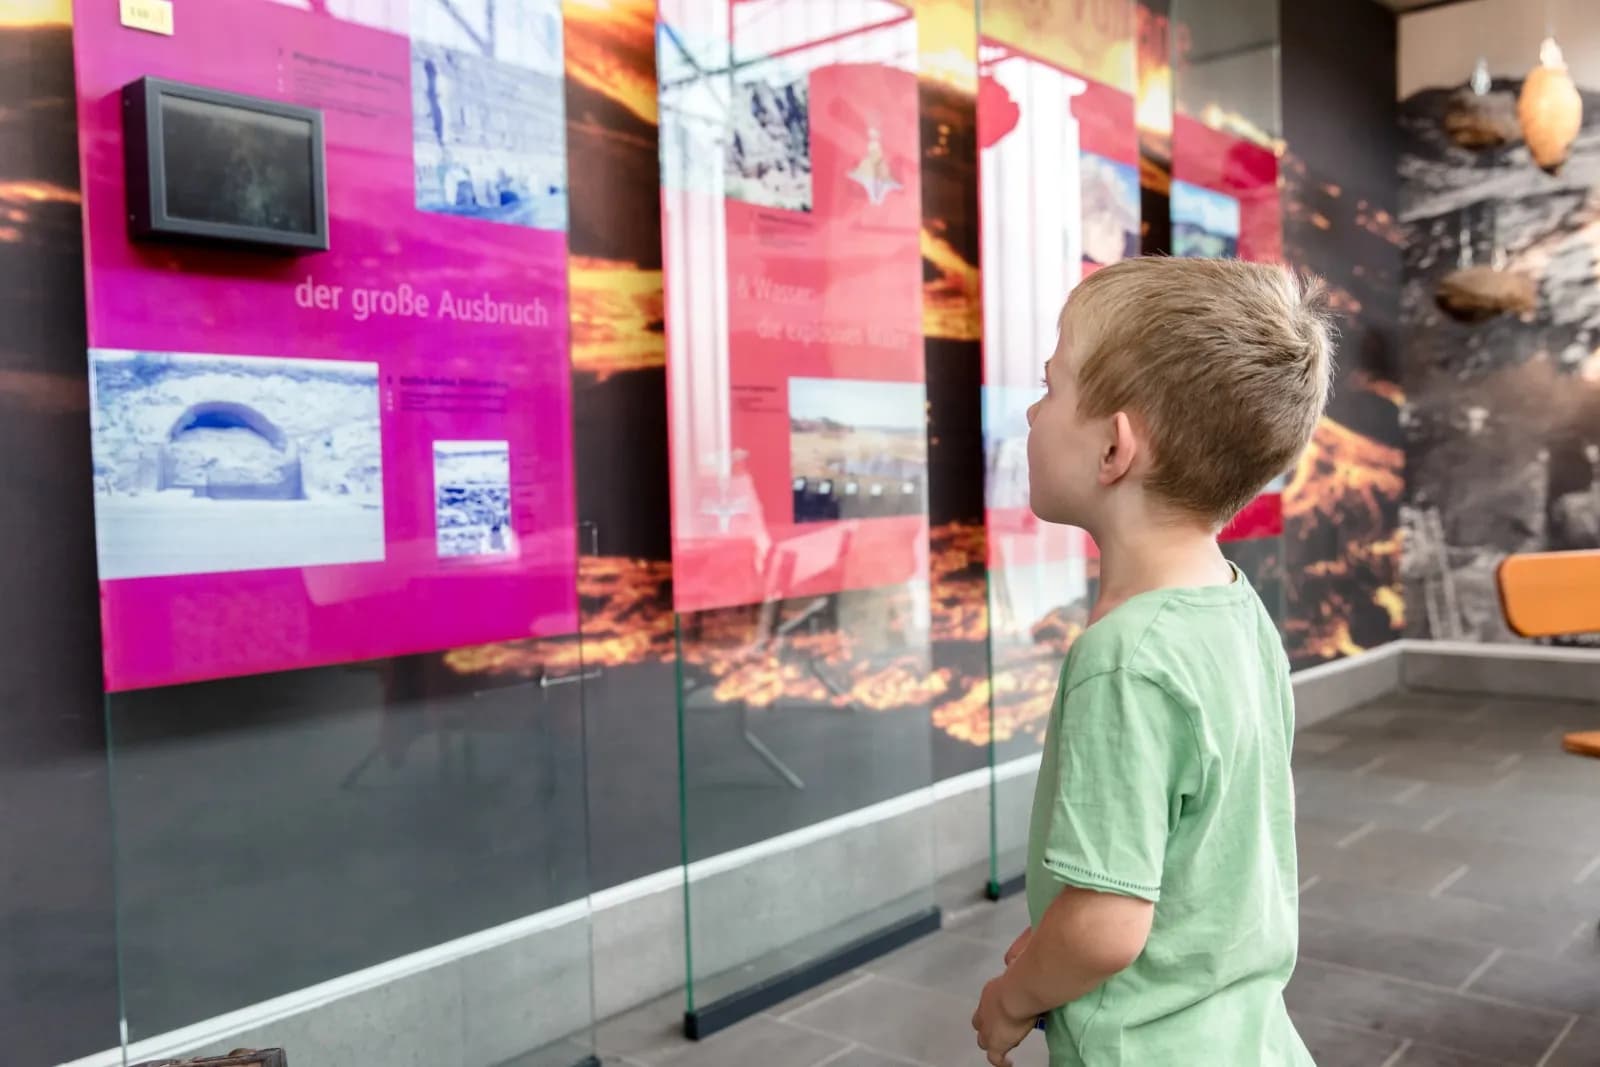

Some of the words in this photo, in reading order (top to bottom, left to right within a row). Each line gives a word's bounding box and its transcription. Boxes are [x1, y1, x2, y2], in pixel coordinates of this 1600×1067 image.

[295, 275, 343, 310] der
[352, 283, 429, 321] große
[438, 290, 549, 327] Ausbruch
